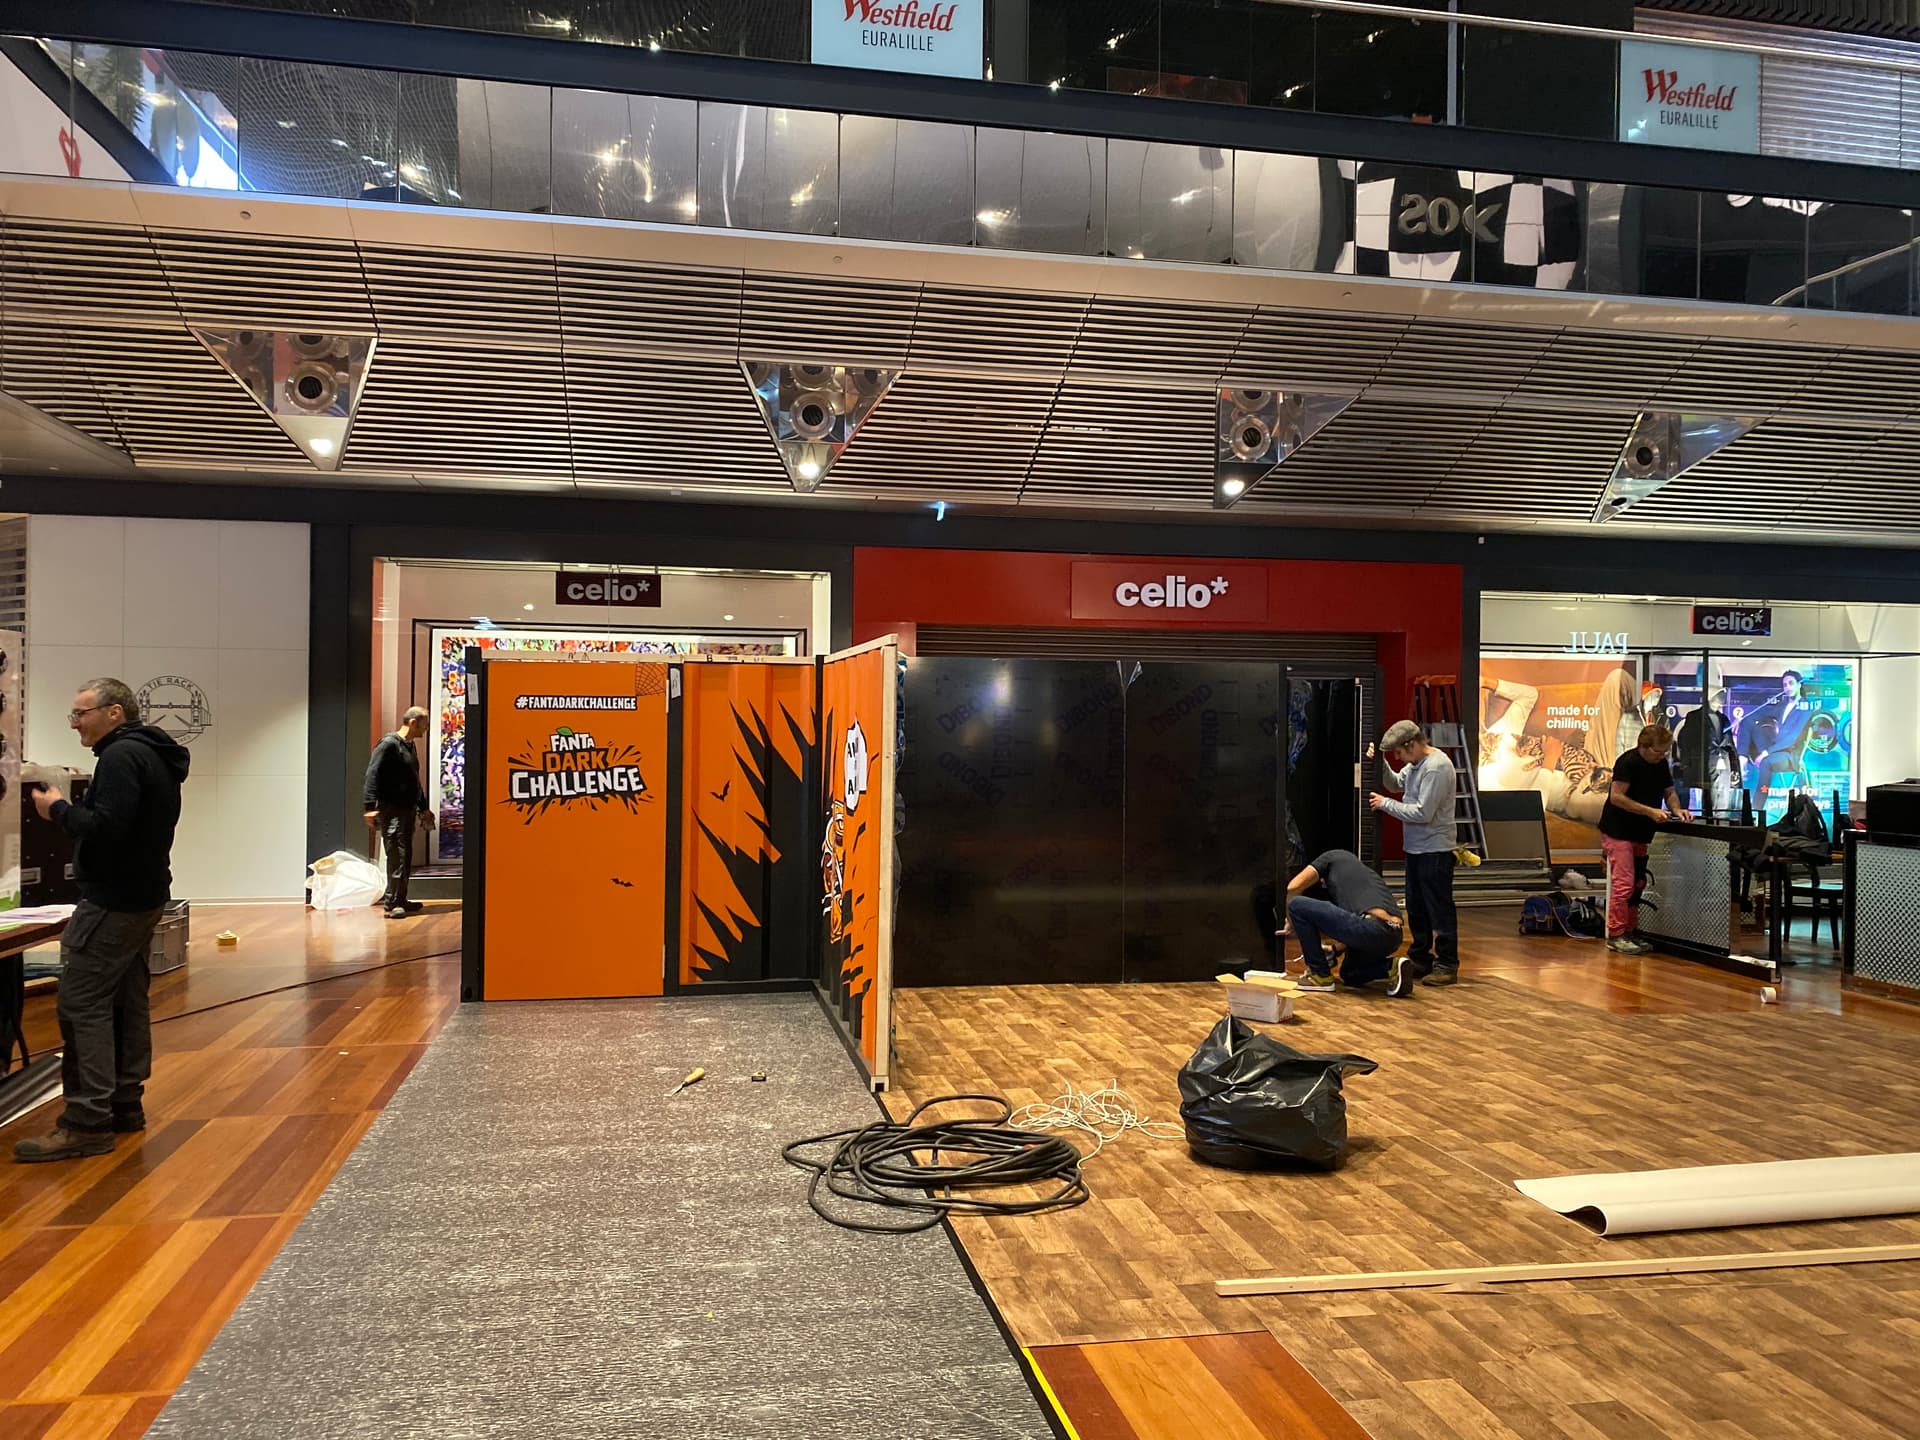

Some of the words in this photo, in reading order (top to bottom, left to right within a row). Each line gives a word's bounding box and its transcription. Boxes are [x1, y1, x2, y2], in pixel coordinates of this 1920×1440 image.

[862, 29, 934, 51] EURALILLE
[1641, 68, 1739, 112] Westfield
[1660, 109, 1719, 130] EURALILLE
[515, 696, 637, 710] #FANTADARKCHALLENGE
[1547, 704, 1581, 716] made
[1583, 704, 1601, 716] for
[1546, 716, 1590, 732] chilling
[550, 733, 596, 752] FANTA
[545, 750, 608, 773] DARK
[511, 767, 644, 799] CHALLENGE
